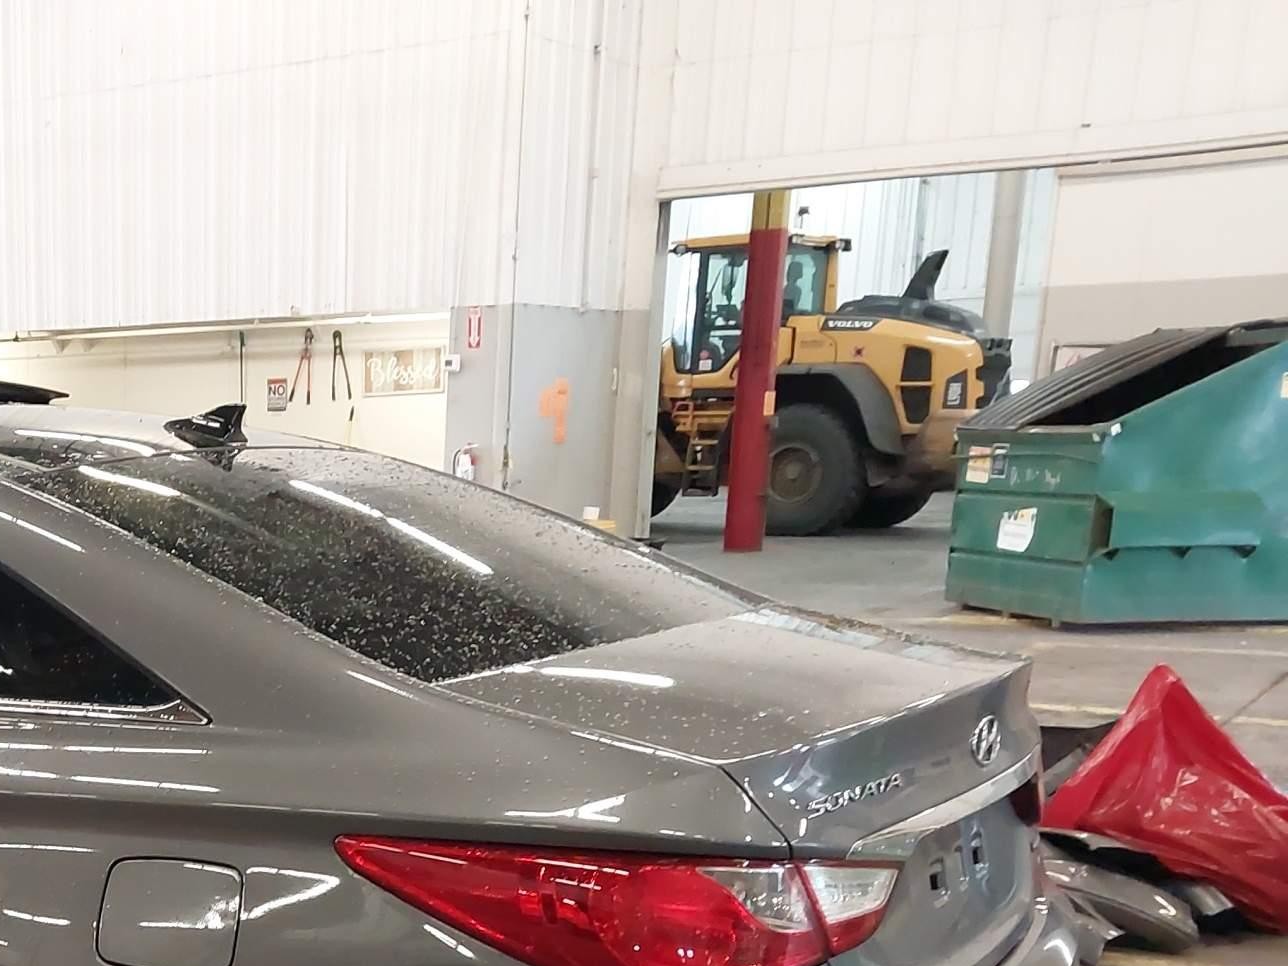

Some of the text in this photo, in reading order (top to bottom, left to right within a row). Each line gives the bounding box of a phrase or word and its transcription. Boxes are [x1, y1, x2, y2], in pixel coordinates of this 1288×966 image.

[826, 319, 874, 328] VOLVO
[366, 356, 440, 387] Blessed
[268, 384, 286, 396] NO
[807, 773, 904, 819] SONATA
